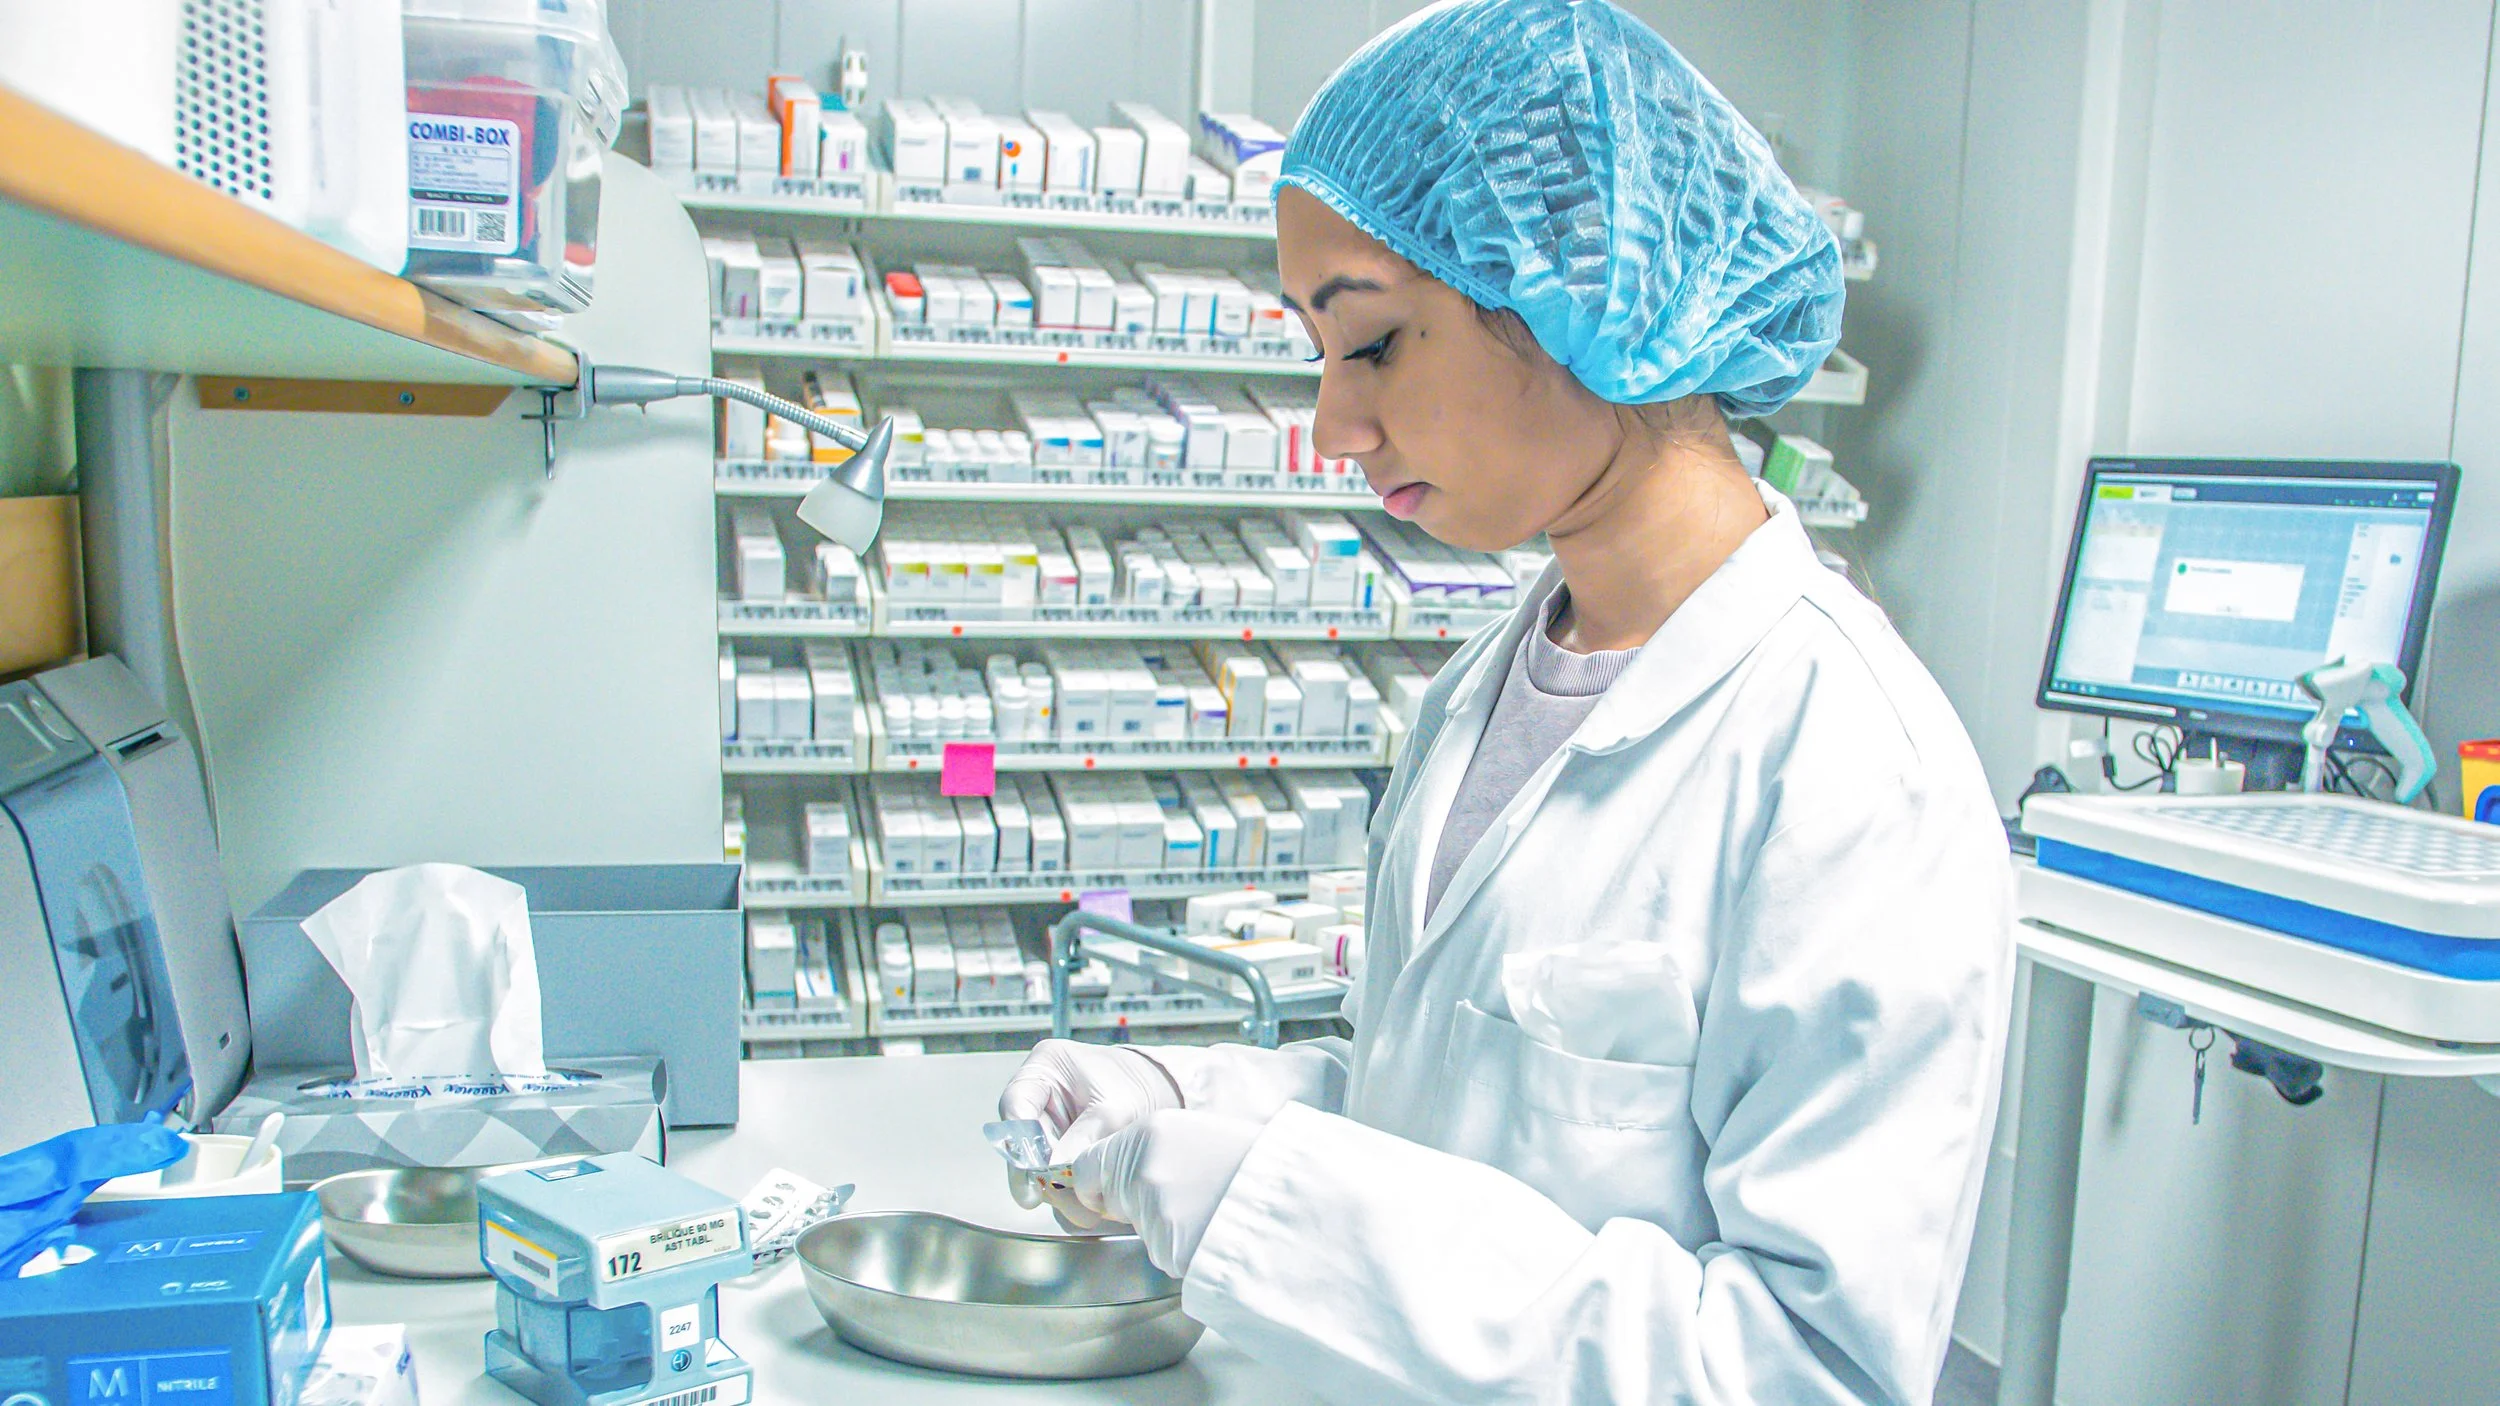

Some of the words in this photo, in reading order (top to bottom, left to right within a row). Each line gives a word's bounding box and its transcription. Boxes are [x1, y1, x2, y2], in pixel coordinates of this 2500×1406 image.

[409, 122, 510, 145] COMBI-BOX
[443, 1082, 510, 1096] Kleenex
[650, 1225, 695, 1244] BRILIQUE
[710, 1218, 725, 1230] MG
[665, 1240, 684, 1253] AST
[608, 1251, 642, 1277] 172
[669, 1322, 692, 1335] 2247
[88, 1367, 129, 1399] M
[157, 1377, 219, 1392] NITRILE
